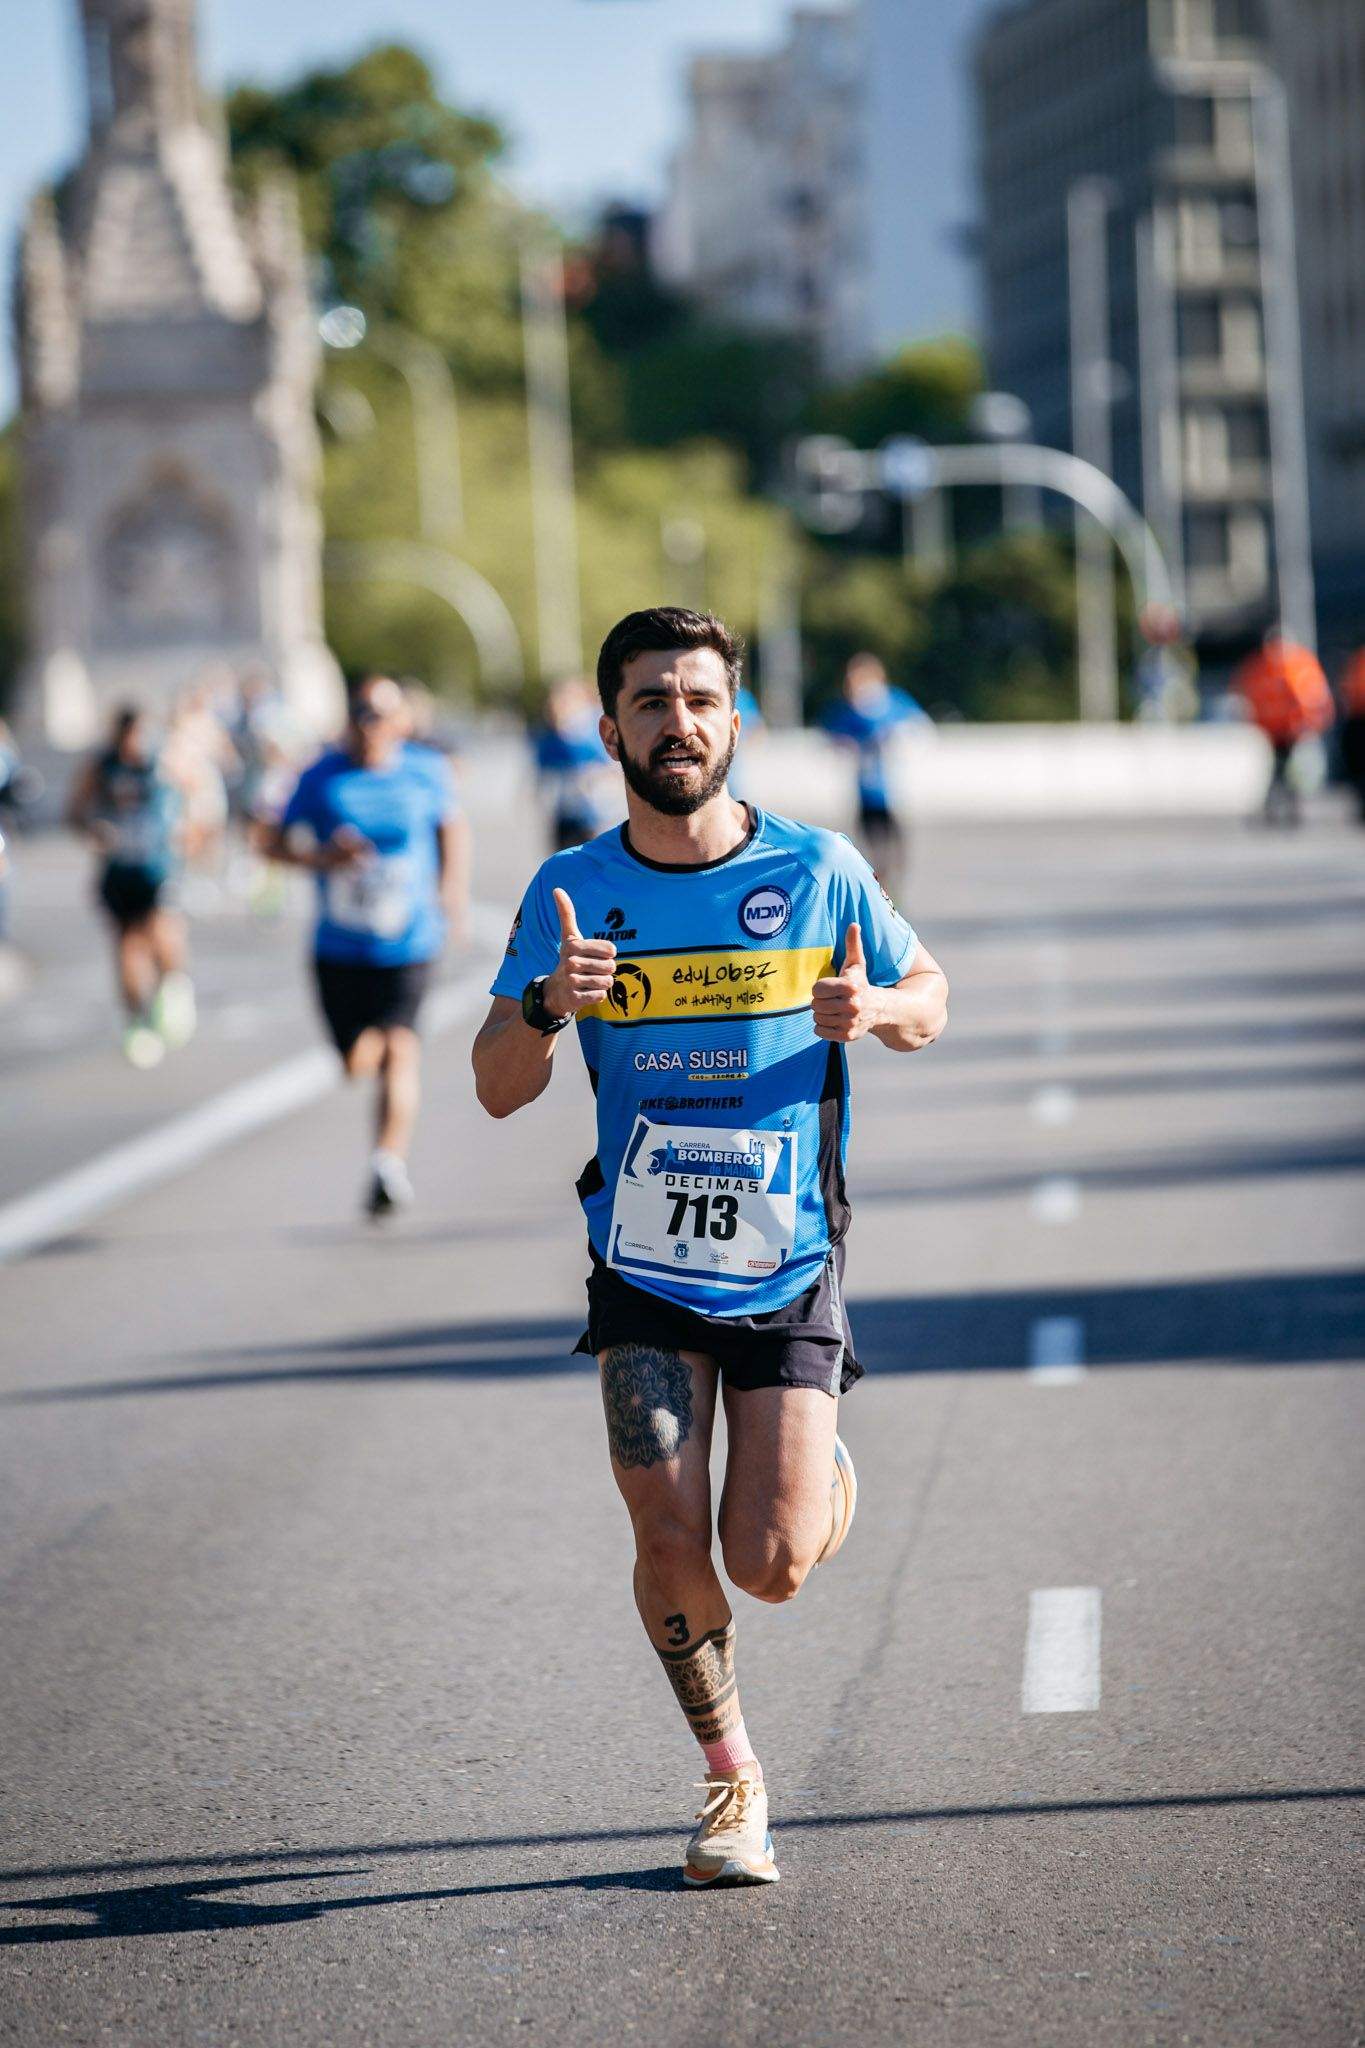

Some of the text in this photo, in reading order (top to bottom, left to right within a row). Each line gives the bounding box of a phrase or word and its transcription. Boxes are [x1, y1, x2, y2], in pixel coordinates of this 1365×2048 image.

[634, 1049, 748, 1071] CASA SUSHI
[679, 1141, 711, 1149] CARRERA
[677, 1149, 762, 1166] BOMBEROS
[724, 1163, 762, 1178] MADRID
[665, 1174, 759, 1193] DECIMAS
[666, 1191, 738, 1241] 713
